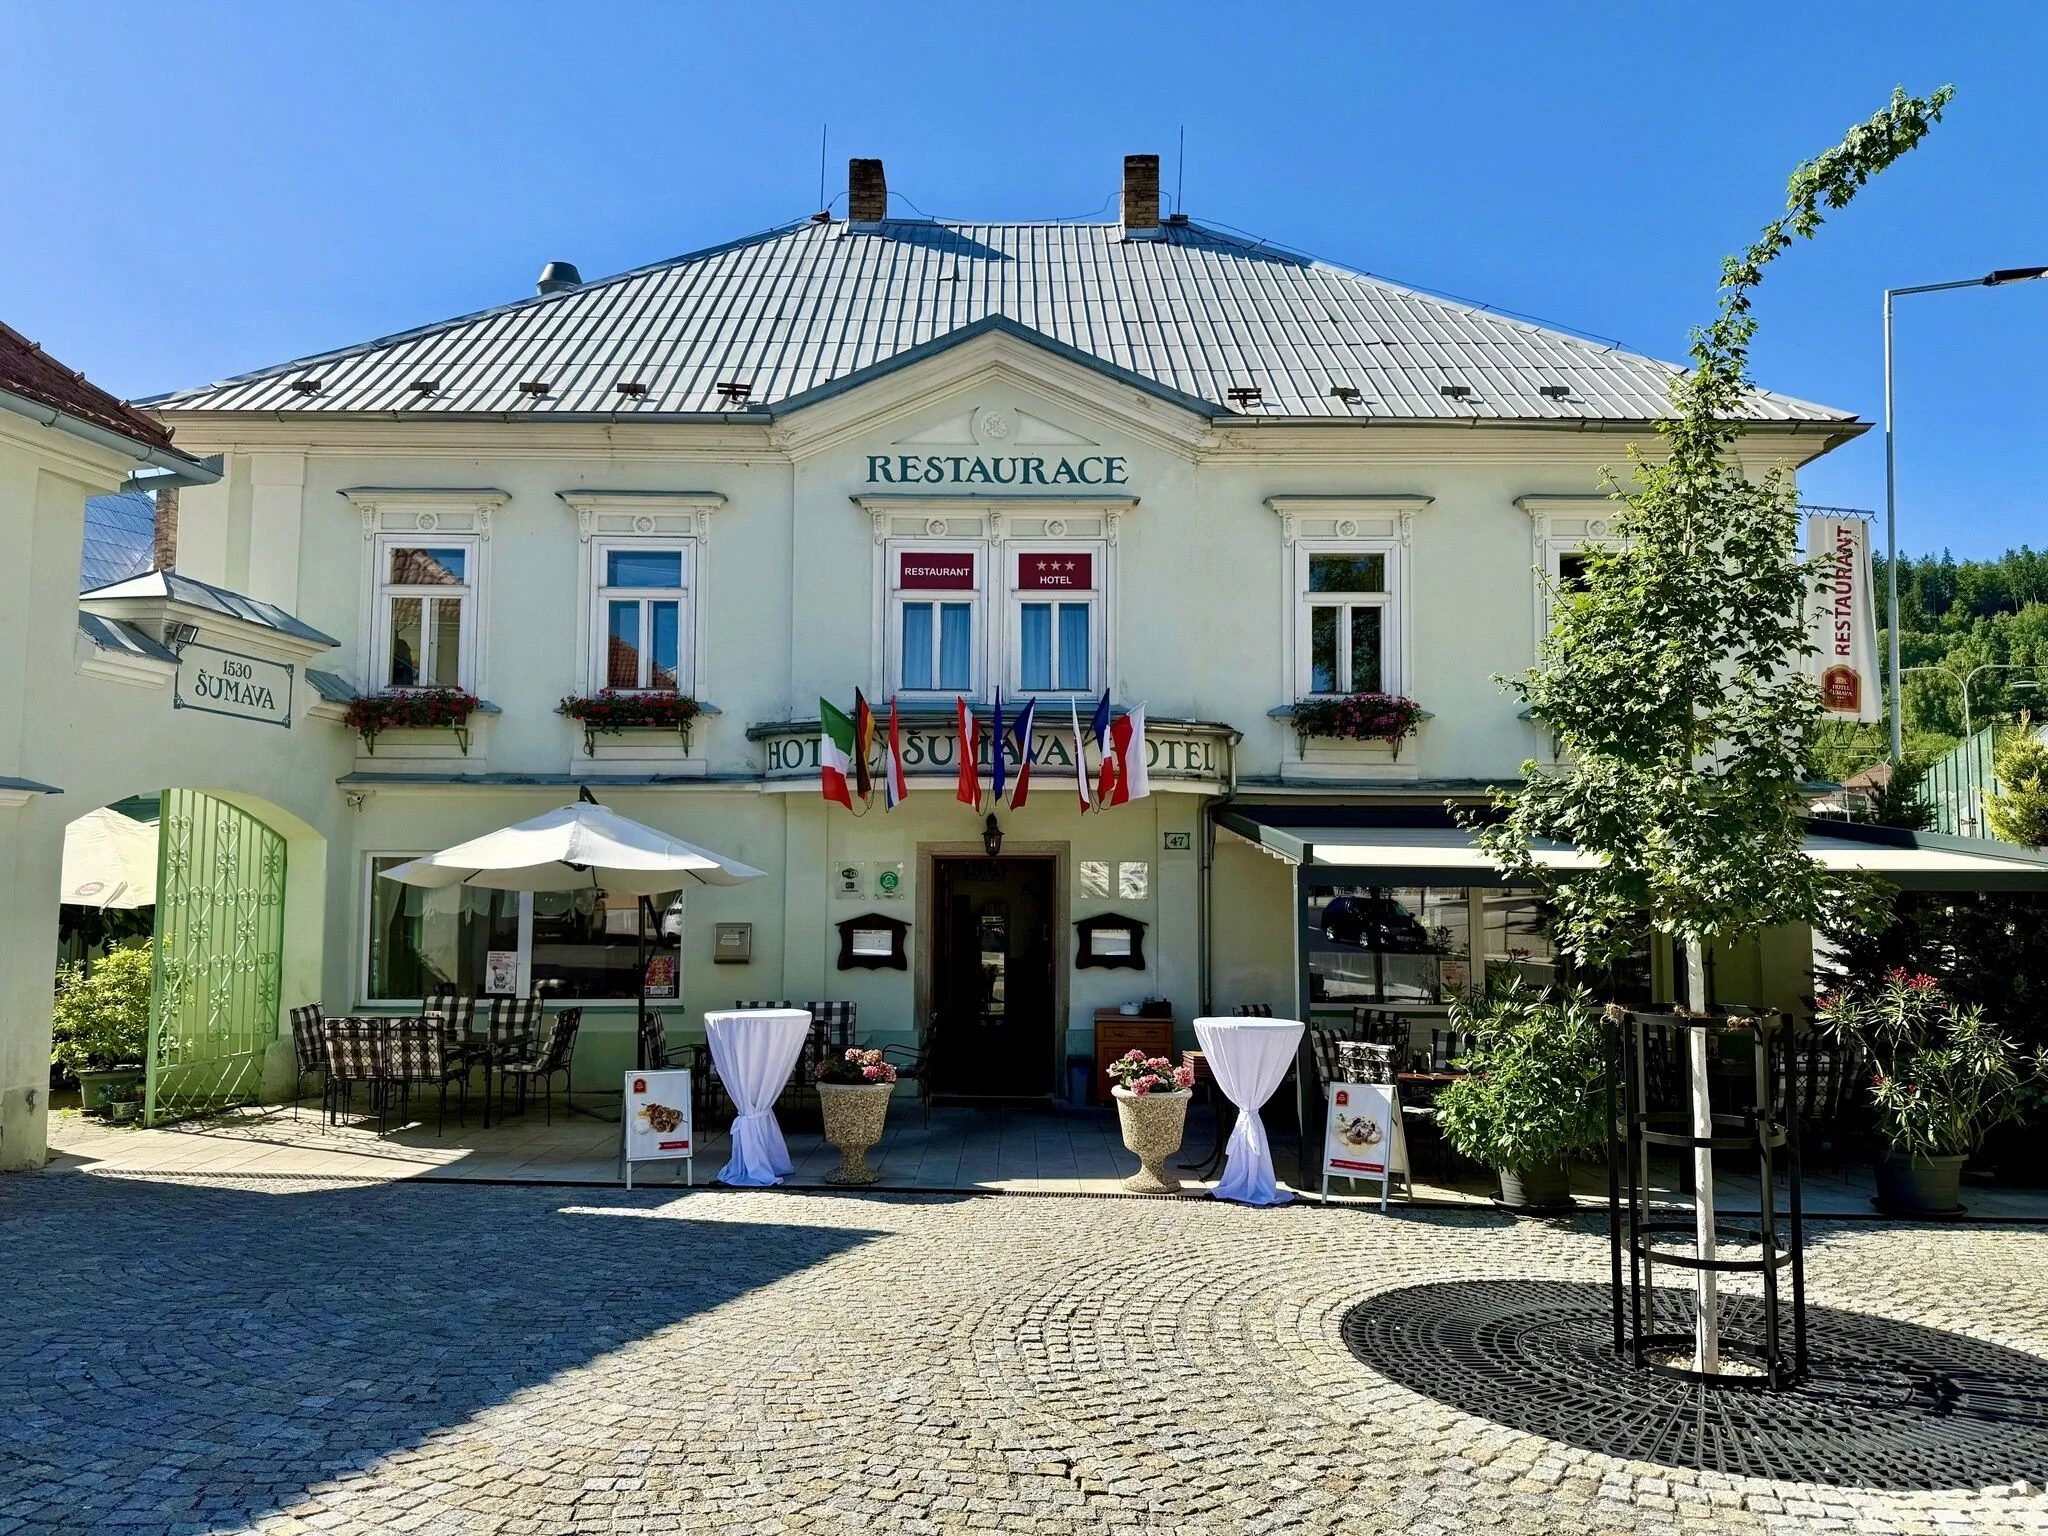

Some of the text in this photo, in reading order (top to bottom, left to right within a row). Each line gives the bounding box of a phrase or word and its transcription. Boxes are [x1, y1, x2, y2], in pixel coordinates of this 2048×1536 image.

[866, 455, 1129, 485] RESTAURACE
[904, 567, 970, 577] RESTAURANT
[1039, 575, 1073, 585] HOTEL
[1835, 525, 1854, 656] RESTAURANT
[222, 659, 252, 680] 1530
[195, 668, 276, 711] ŠUMAVA
[1170, 836, 1184, 846] 47
